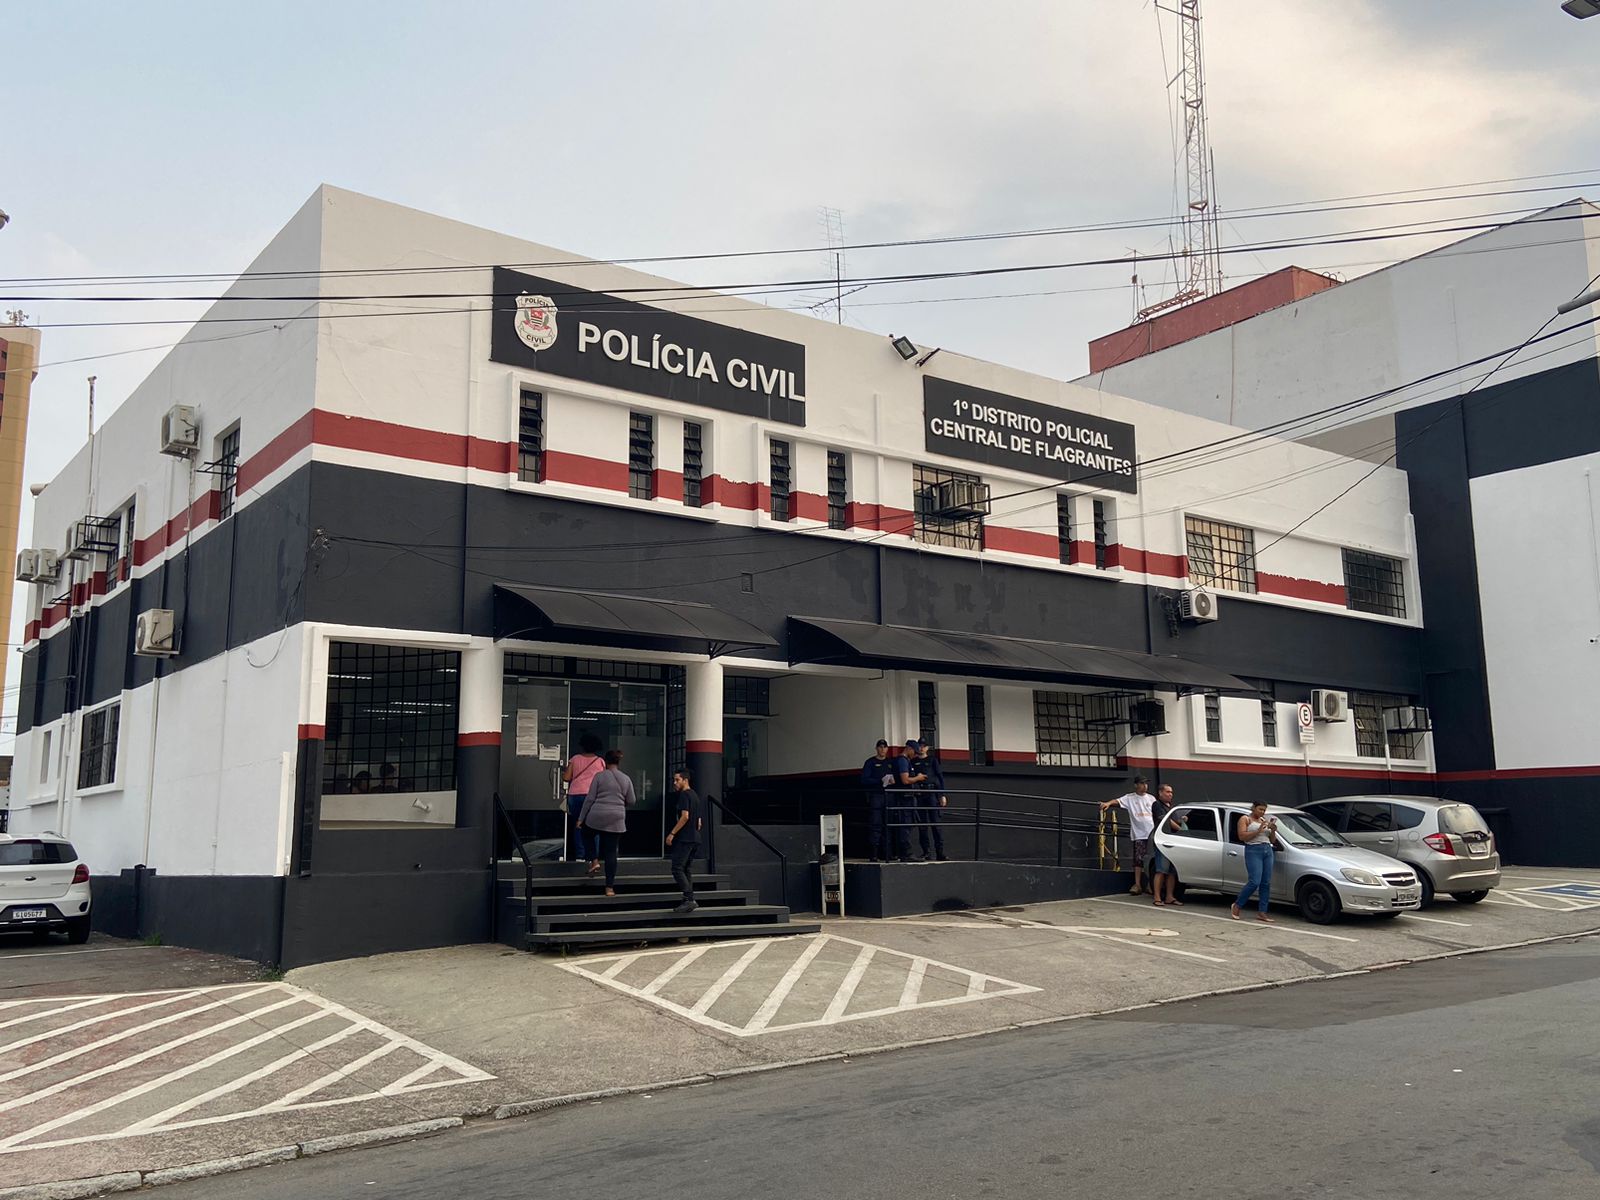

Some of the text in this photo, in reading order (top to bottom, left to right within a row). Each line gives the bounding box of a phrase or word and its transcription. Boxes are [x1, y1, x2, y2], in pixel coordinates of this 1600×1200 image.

[526, 334, 546, 344] CIVIL
[578, 321, 806, 402] POLÍCIA CIVIL
[930, 417, 1133, 477] CENTRAL DE FLAGRANTES
[972, 403, 1042, 434] DISTRITO
[1046, 420, 1114, 451] POLICIAL
[1303, 709, 1309, 721] E
